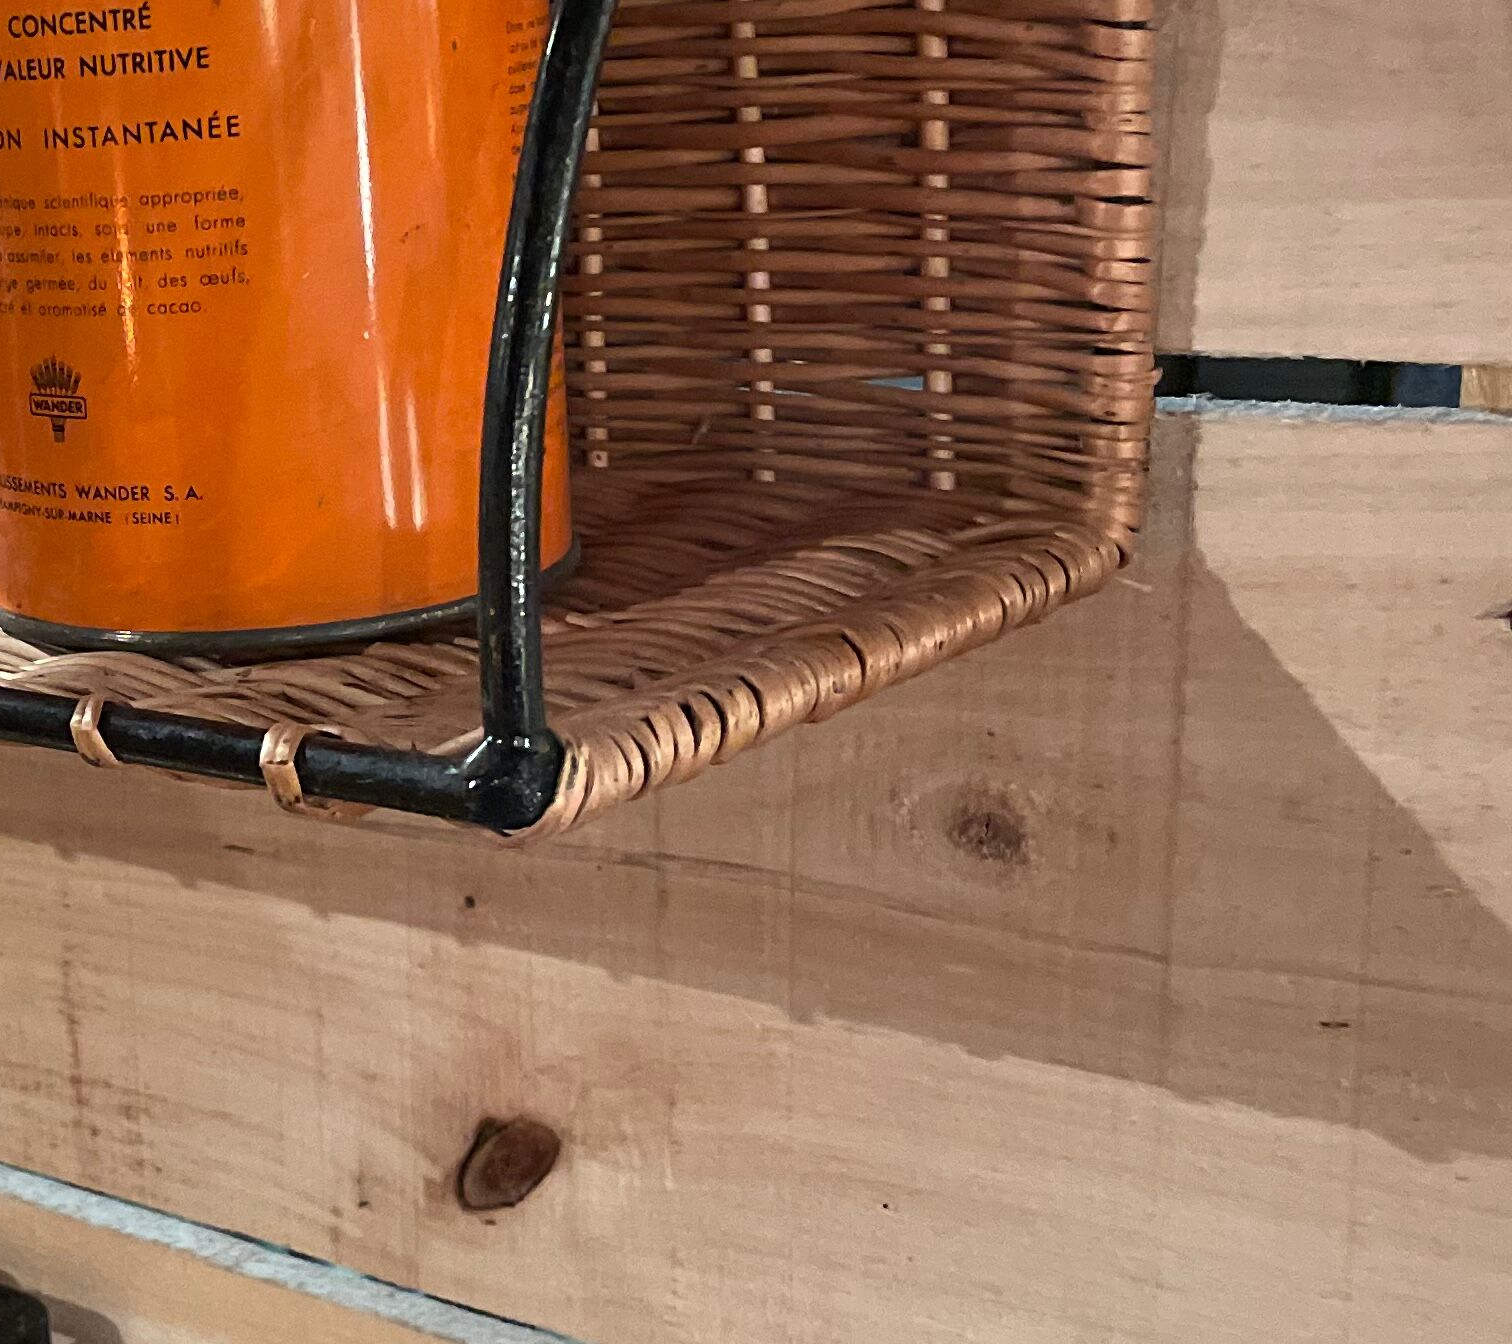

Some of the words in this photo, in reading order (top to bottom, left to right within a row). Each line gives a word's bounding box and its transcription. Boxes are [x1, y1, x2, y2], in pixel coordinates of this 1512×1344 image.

[7, 1, 152, 39] CONCENTRÉ
[79, 46, 210, 78] NUTRITIVE
[43, 110, 241, 150] INSTANTANÉE
[139, 185, 244, 208] appropriée,
[146, 221, 178, 234] une
[195, 214, 246, 231] forme
[185, 239, 248, 258] nutritifs
[88, 276, 107, 291] du
[157, 273, 188, 288] des
[33, 398, 84, 414] WANDER
[75, 485, 150, 502] WANDER
[163, 484, 179, 502] S.
[185, 485, 203, 501] A.
